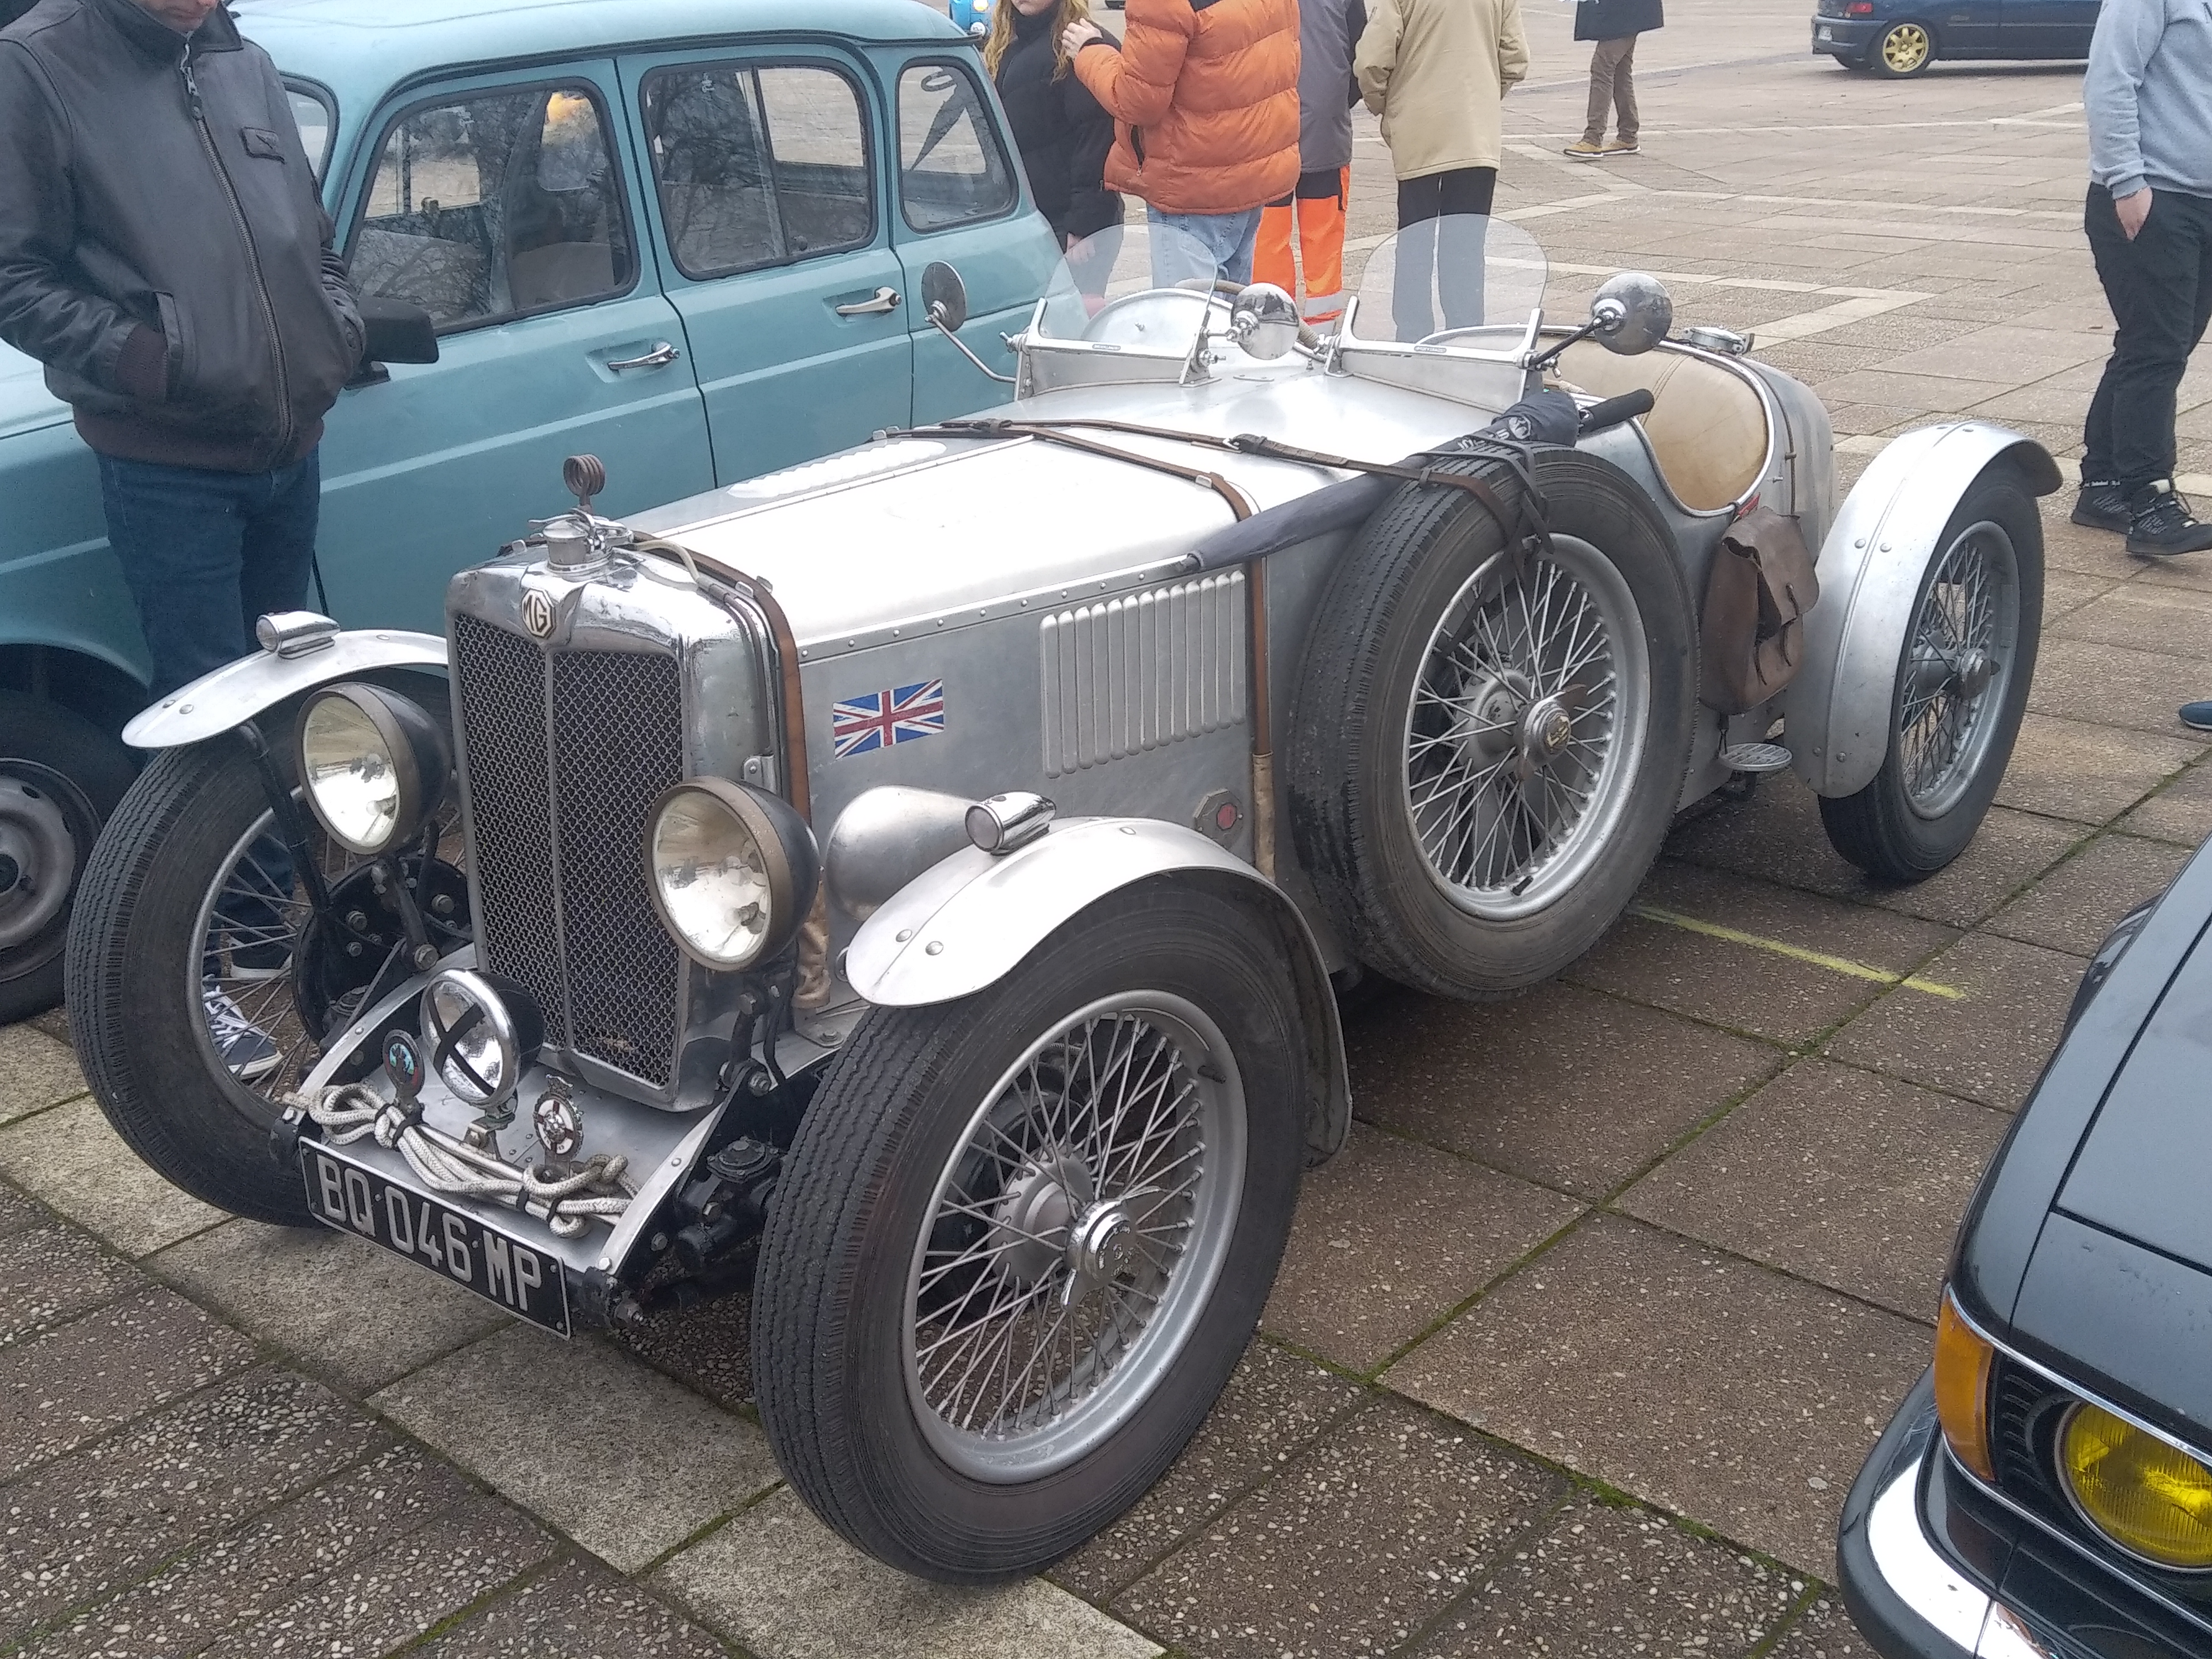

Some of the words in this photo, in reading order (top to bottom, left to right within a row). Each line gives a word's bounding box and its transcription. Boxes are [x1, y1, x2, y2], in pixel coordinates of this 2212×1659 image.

[523, 594, 547, 633] MG
[317, 1154, 376, 1237] BQ
[385, 1185, 472, 1282] 046
[483, 1230, 541, 1311] MP
